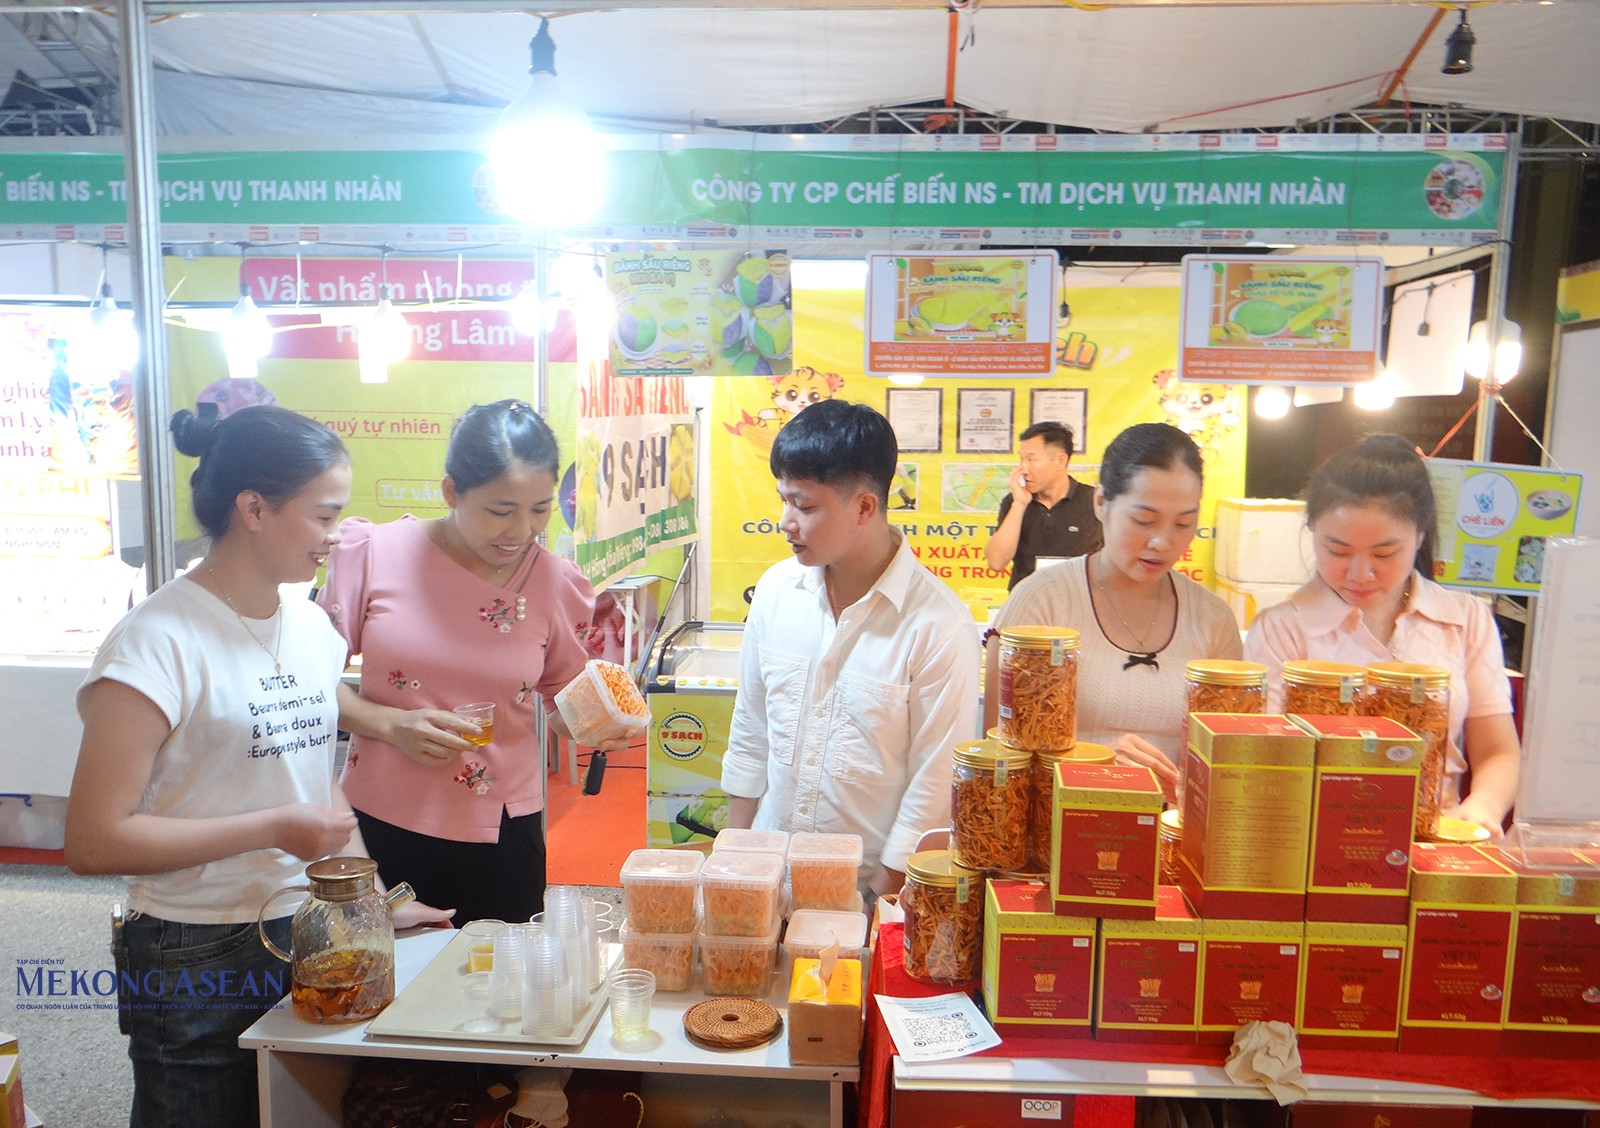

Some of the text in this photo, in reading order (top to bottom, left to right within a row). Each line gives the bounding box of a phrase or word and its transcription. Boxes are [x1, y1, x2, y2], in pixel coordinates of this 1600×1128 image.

[6, 172, 55, 201] BIẾN
[61, 180, 90, 202] NS
[211, 180, 242, 207] VỤ
[248, 180, 327, 201] THANH
[334, 174, 402, 201] NHÀN
[692, 173, 762, 203] CÔNG
[769, 182, 796, 204] TY
[804, 182, 839, 204] CP
[846, 173, 900, 204] CHẾ
[903, 172, 957, 204] BIẾN
[964, 182, 996, 204] NS
[1018, 182, 1052, 205] TM
[1060, 182, 1124, 211] DỊCH
[1132, 182, 1168, 211] VỤ
[1174, 182, 1262, 205] THANH
[1270, 176, 1345, 205] NHÀN
[451, 319, 515, 345] Lâm
[363, 419, 384, 436] tự
[390, 418, 441, 434] nhiên
[380, 483, 407, 500] Tư
[925, 521, 978, 540] MỘT
[259, 674, 298, 691] BUTTER
[252, 724, 261, 739] &
[291, 716, 322, 730] doux
[671, 731, 703, 742] SẠCH
[1024, 1100, 1059, 1112] OCOP
